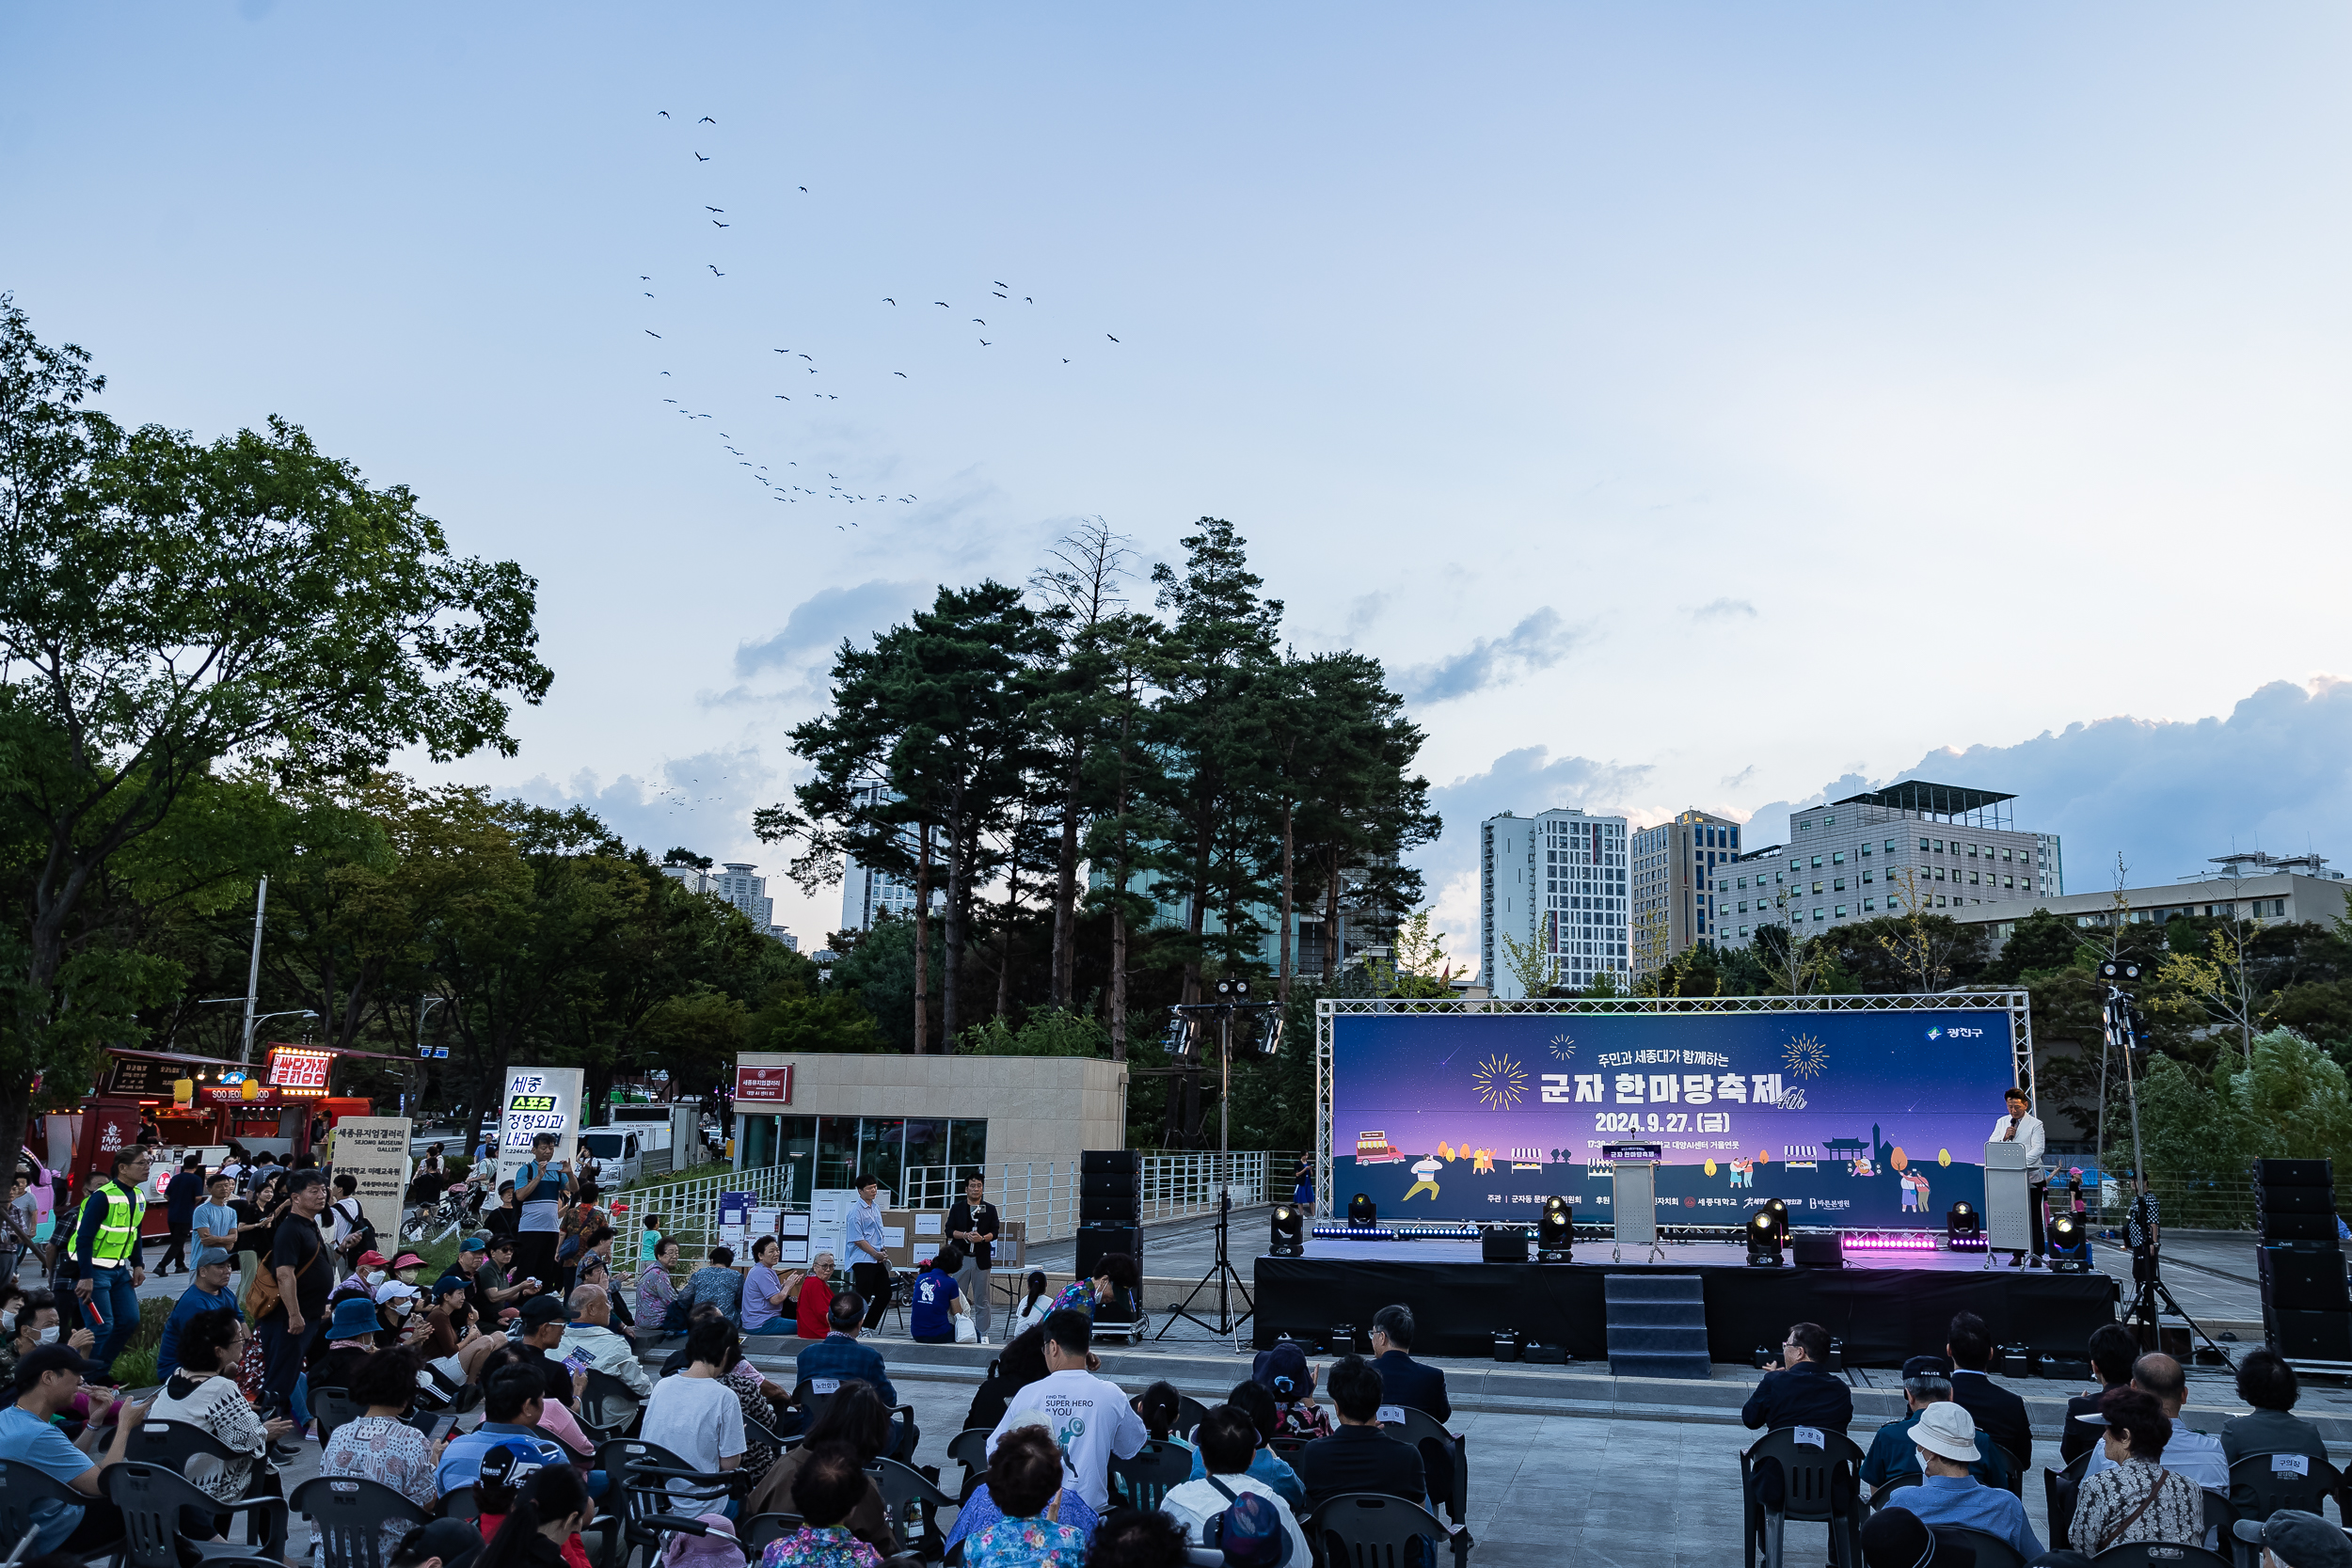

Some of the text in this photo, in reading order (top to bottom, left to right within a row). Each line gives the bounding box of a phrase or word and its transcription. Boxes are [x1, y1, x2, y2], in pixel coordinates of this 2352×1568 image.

[1947, 1027, 1983, 1038] 광진구
[1598, 1049, 1729, 1068] 주민과 세종대가 함께하는
[278, 1056, 327, 1085] 쌀닭강정
[511, 1076, 542, 1093] 세종
[1541, 1073, 1784, 1105] 군자 한마당축제
[212, 1090, 227, 1099] SOO
[1770, 1085, 1807, 1110] 4th
[512, 1098, 551, 1111] 스포츠
[507, 1115, 564, 1130] 정형외과
[339, 1129, 405, 1139] 세종뮤지엄갤러리
[102, 1135, 122, 1145] TAKO
[1672, 1140, 1708, 1150] 대양AI센터
[1709, 1140, 1740, 1150] 거울연못
[101, 1144, 122, 1152] NEKO
[333, 1167, 401, 1176] 세종대학교 미래교육원
[1487, 1195, 1502, 1203] 주관
[1511, 1195, 1532, 1204] 군자동
[1596, 1196, 1611, 1204] 후원
[1697, 1197, 1738, 1207] 세종대학교
[1072, 1400, 1094, 1408] HERO
[1052, 1407, 1073, 1417] YOU
